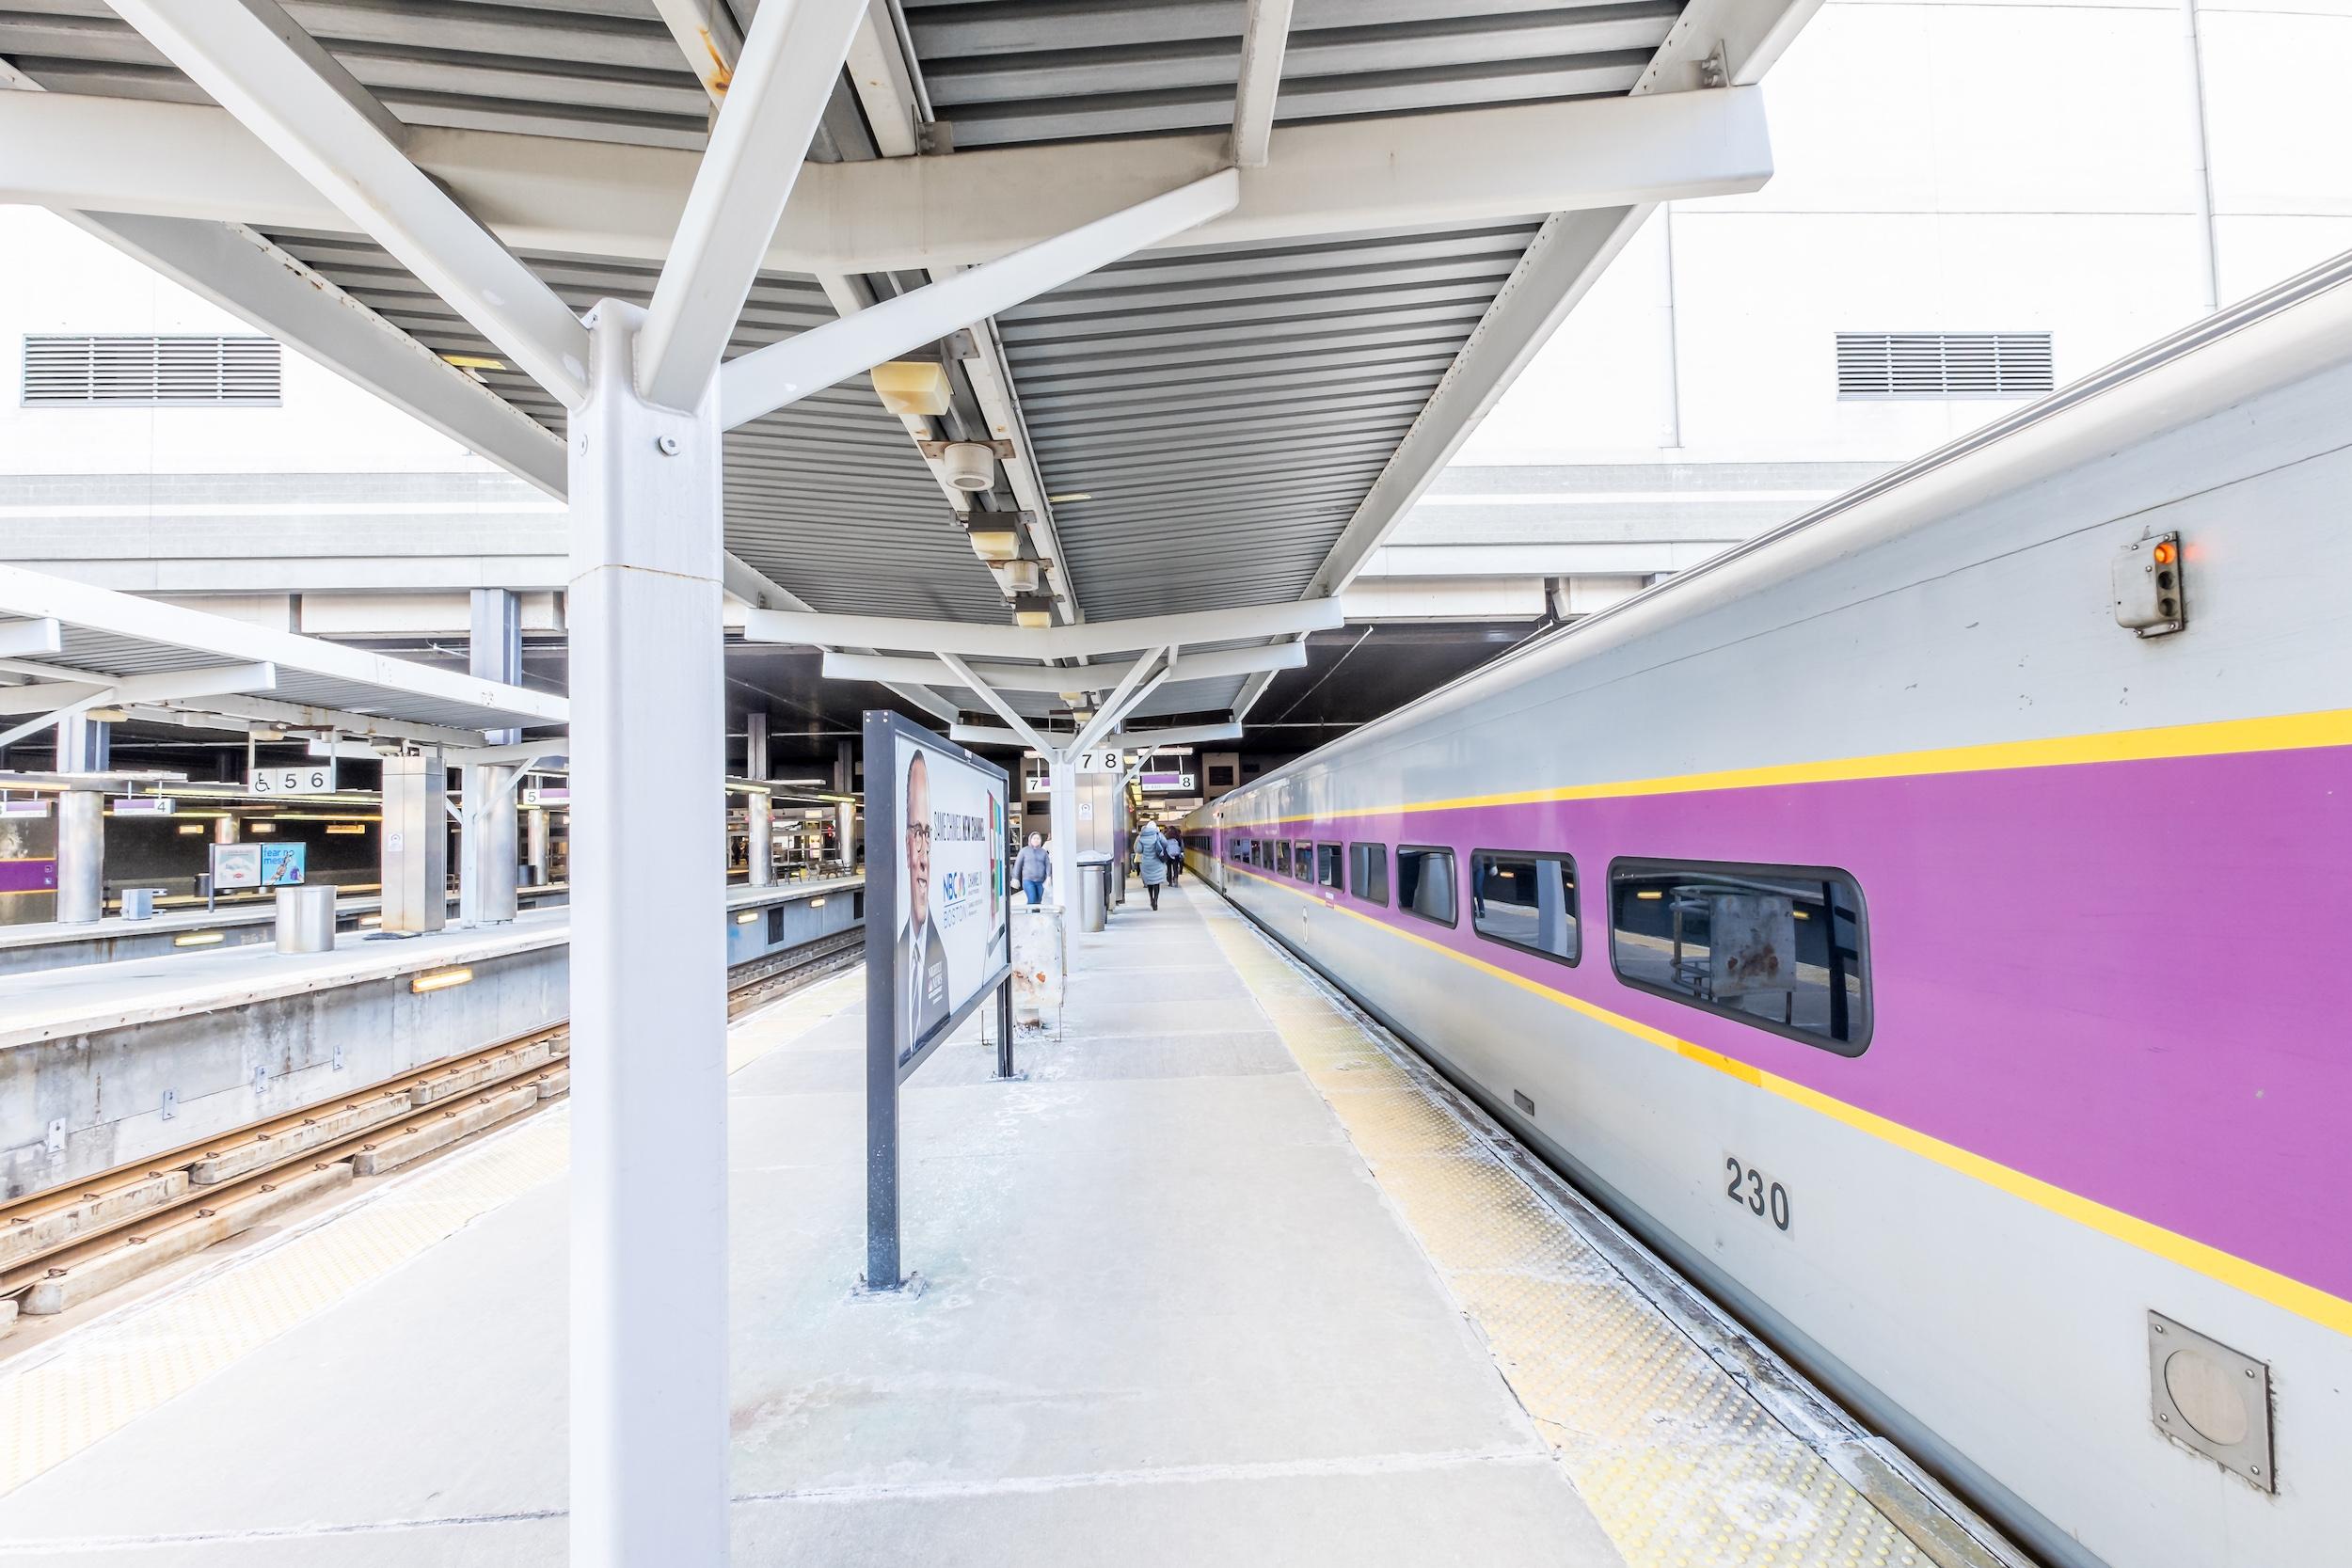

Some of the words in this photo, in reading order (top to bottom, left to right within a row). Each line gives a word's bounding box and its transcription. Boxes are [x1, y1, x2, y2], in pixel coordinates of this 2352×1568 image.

[1082, 754, 1092, 768] 7
[1104, 753, 1117, 768] 8
[285, 773, 296, 788] 5
[310, 772, 324, 787] 6
[1030, 780, 1039, 790] 7
[1183, 777, 1191, 787] 8
[527, 791, 536, 802] 5
[157, 801, 166, 813] 4
[962, 815, 971, 841] NEW
[263, 847, 280, 857] fear
[943, 871, 958, 902] NBC
[944, 903, 966, 929] BOSTON
[1726, 1157, 1789, 1231] 230
